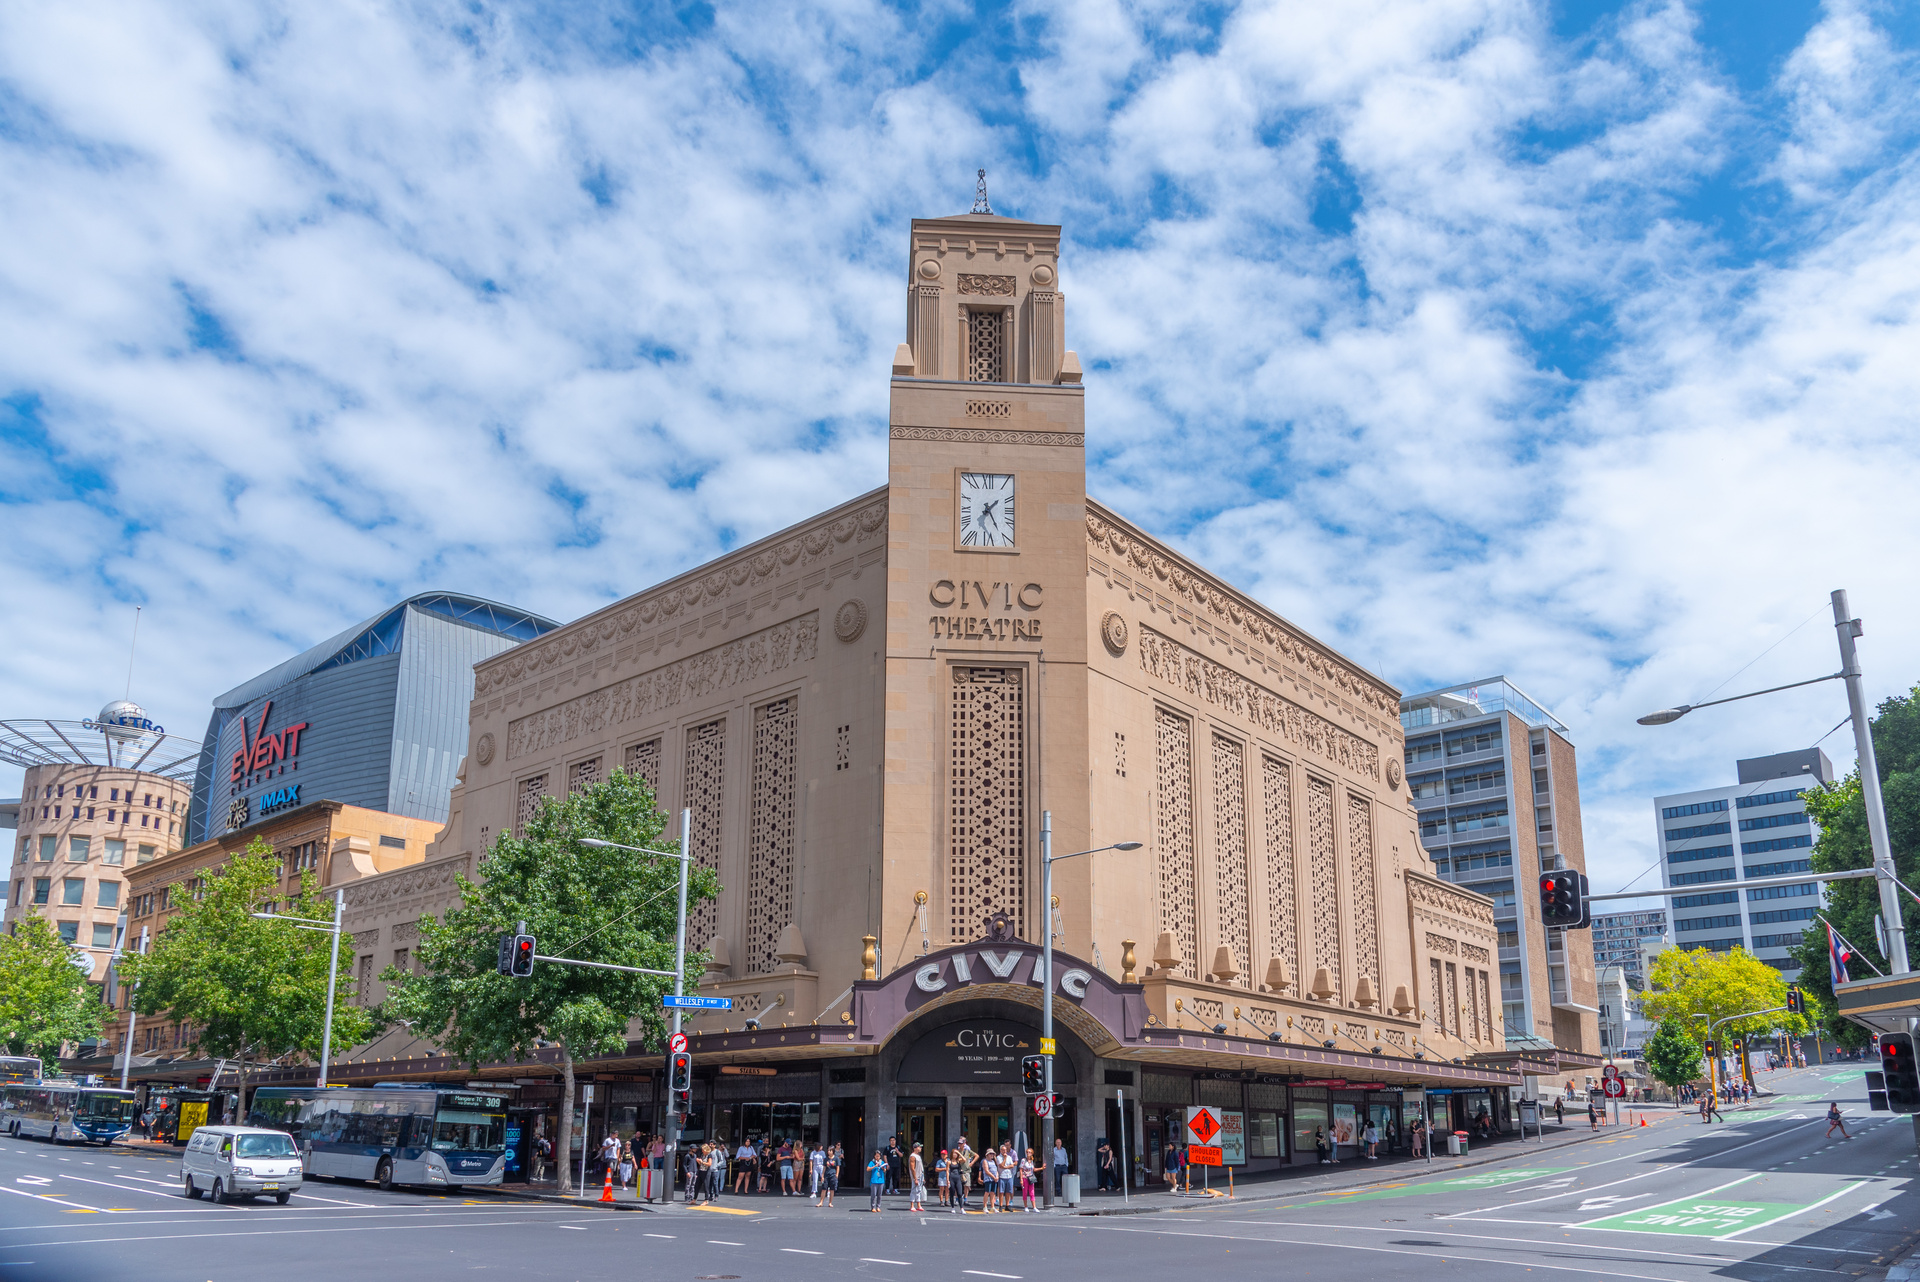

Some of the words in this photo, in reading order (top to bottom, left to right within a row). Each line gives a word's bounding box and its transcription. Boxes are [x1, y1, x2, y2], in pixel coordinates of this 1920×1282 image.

[929, 579, 1044, 610] CIVIC
[929, 616, 1043, 642] THEATRE
[230, 700, 308, 783] EVENT
[260, 784, 299, 810] IMAX
[228, 796, 246, 814] GOLD
[225, 807, 248, 830] CLASS
[915, 950, 1093, 999] CIVIC
[674, 997, 705, 1006] WELLESLEY
[957, 1029, 1015, 1048] CIVIC
[1607, 1084, 1620, 1092] 30
[485, 1097, 501, 1108] 309
[1221, 1122, 1242, 1130] MUSICAL
[1230, 1115, 1242, 1123] BEST
[1191, 1147, 1220, 1156] SHOULDER
[1195, 1155, 1216, 1164] CLOSED
[1677, 1205, 1766, 1217] BUS
[1624, 1214, 1745, 1229] LANE
